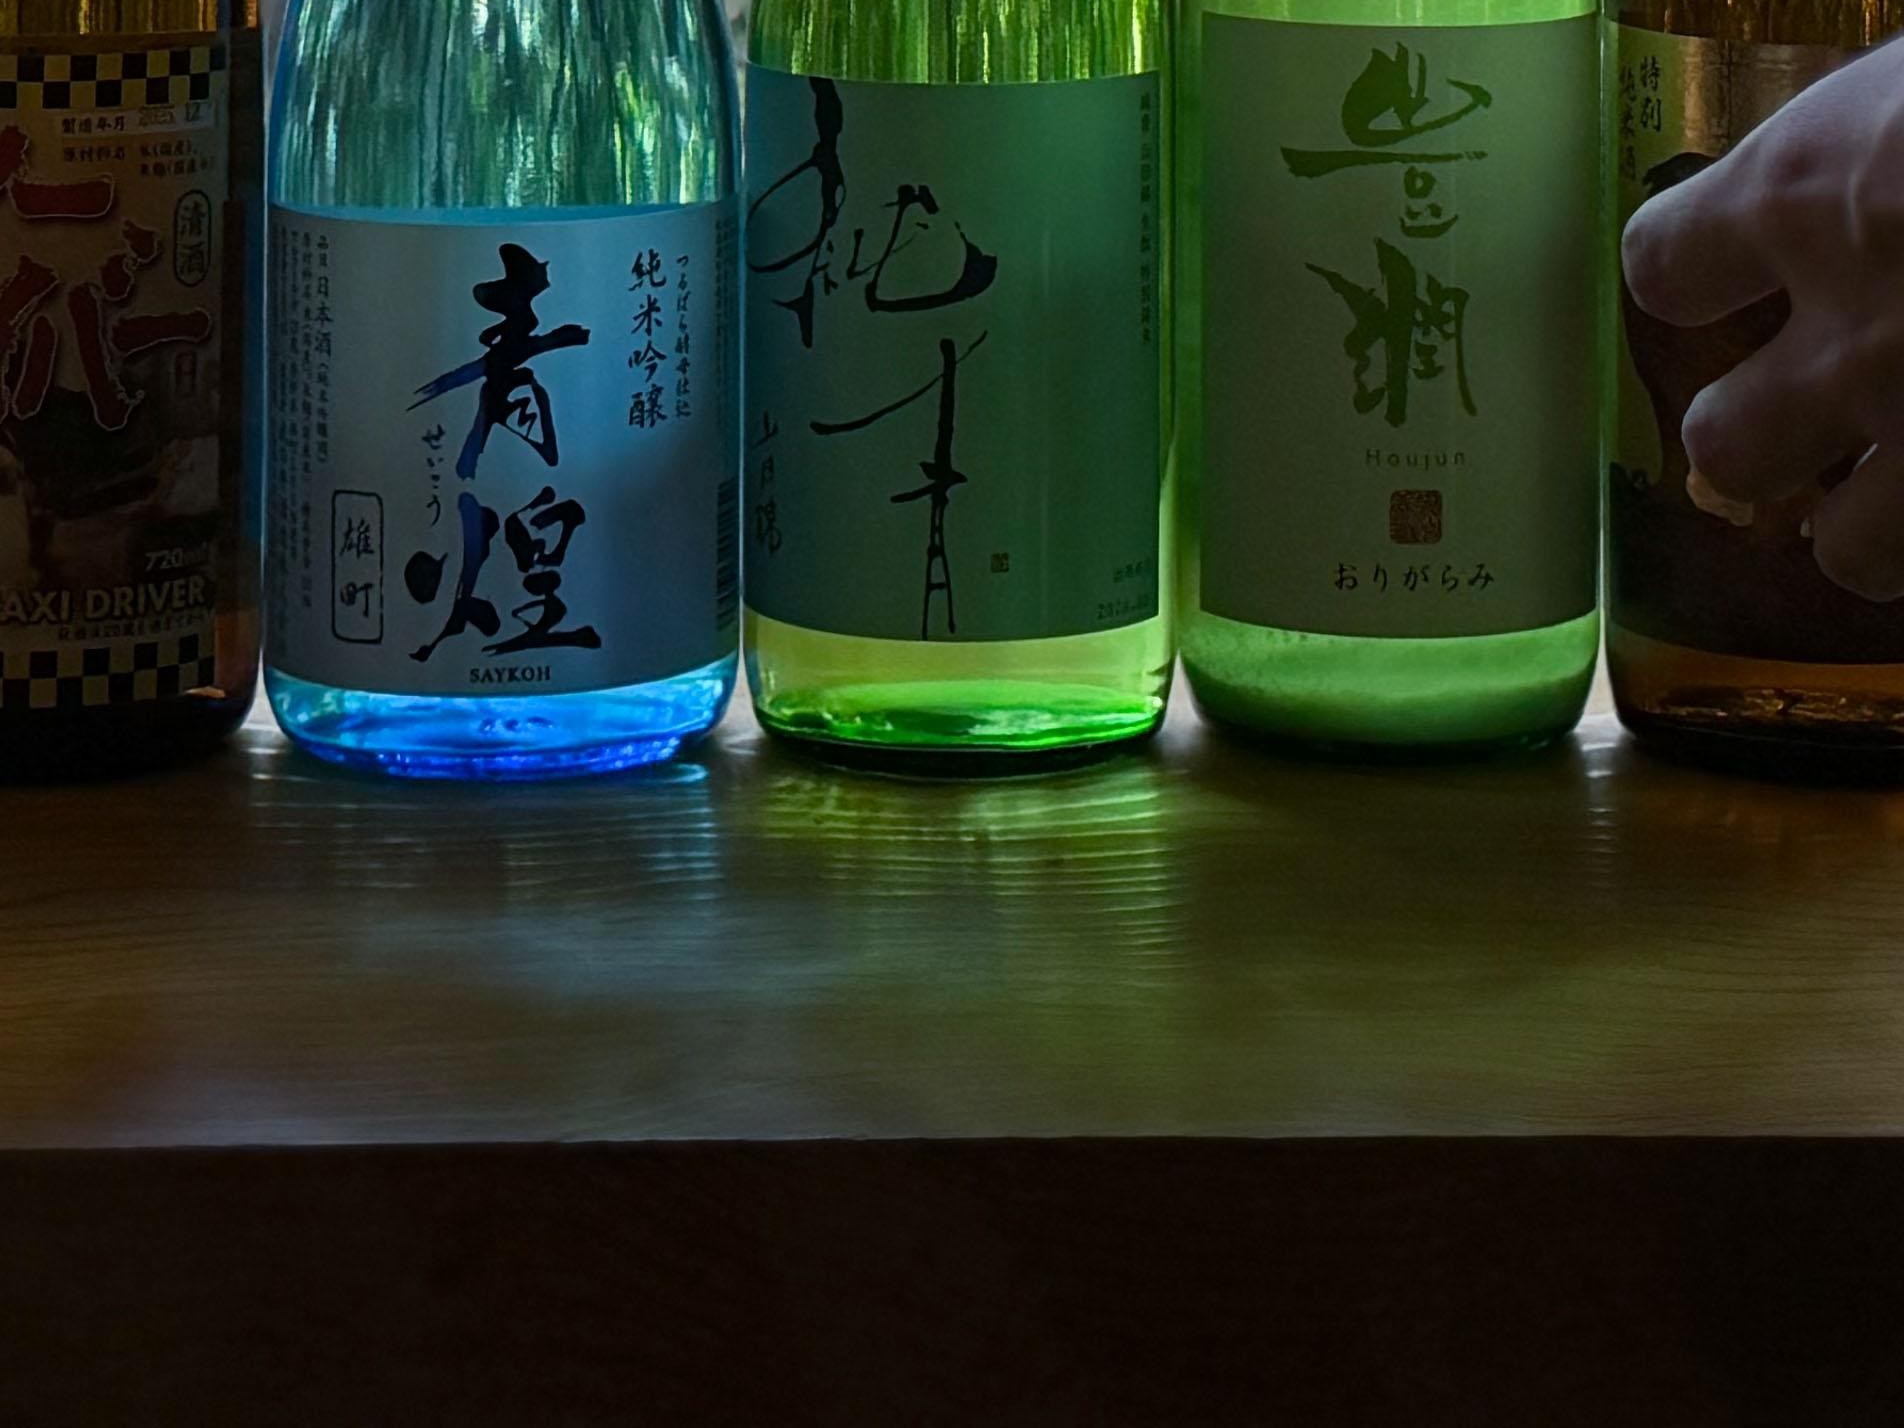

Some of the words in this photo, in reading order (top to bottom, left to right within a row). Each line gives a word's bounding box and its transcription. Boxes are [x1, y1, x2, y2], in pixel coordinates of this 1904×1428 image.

[628, 248, 669, 430] 純米吟醸
[406, 243, 602, 662] 青煌
[421, 423, 447, 527] せいこう
[1366, 448, 1467, 471] Houjun
[86, 575, 207, 618] DRIVER
[339, 518, 375, 619] 雄町
[1332, 562, 1496, 593] おりがらみ
[469, 667, 551, 684] SAYKOH
